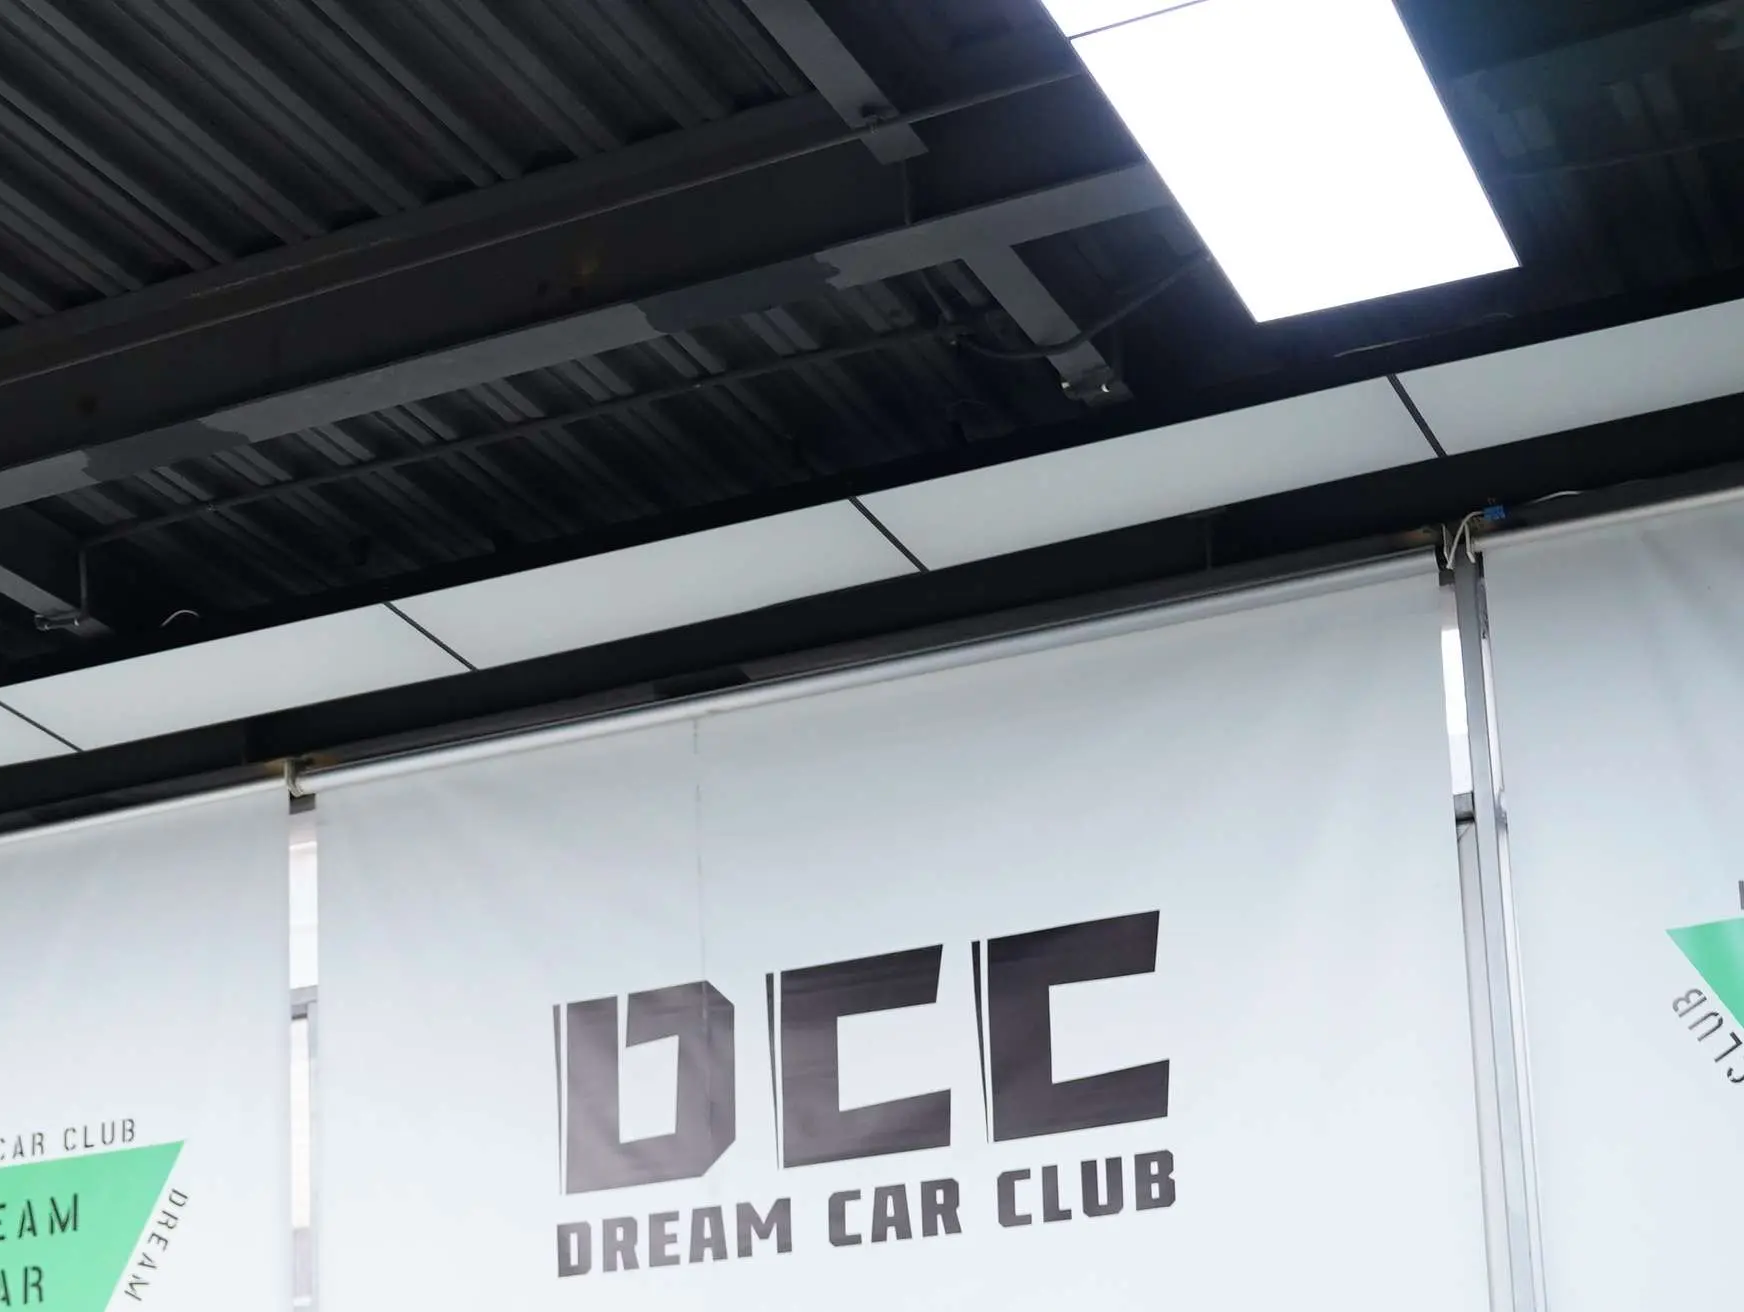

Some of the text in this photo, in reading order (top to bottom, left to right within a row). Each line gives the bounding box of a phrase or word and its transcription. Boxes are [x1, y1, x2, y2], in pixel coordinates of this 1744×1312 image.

[553, 909, 1170, 1196] DCC
[63, 1118, 135, 1152] CLUB
[123, 1188, 189, 1302] DREAM
[556, 1149, 1177, 1279] DREAM CAR CLUB
